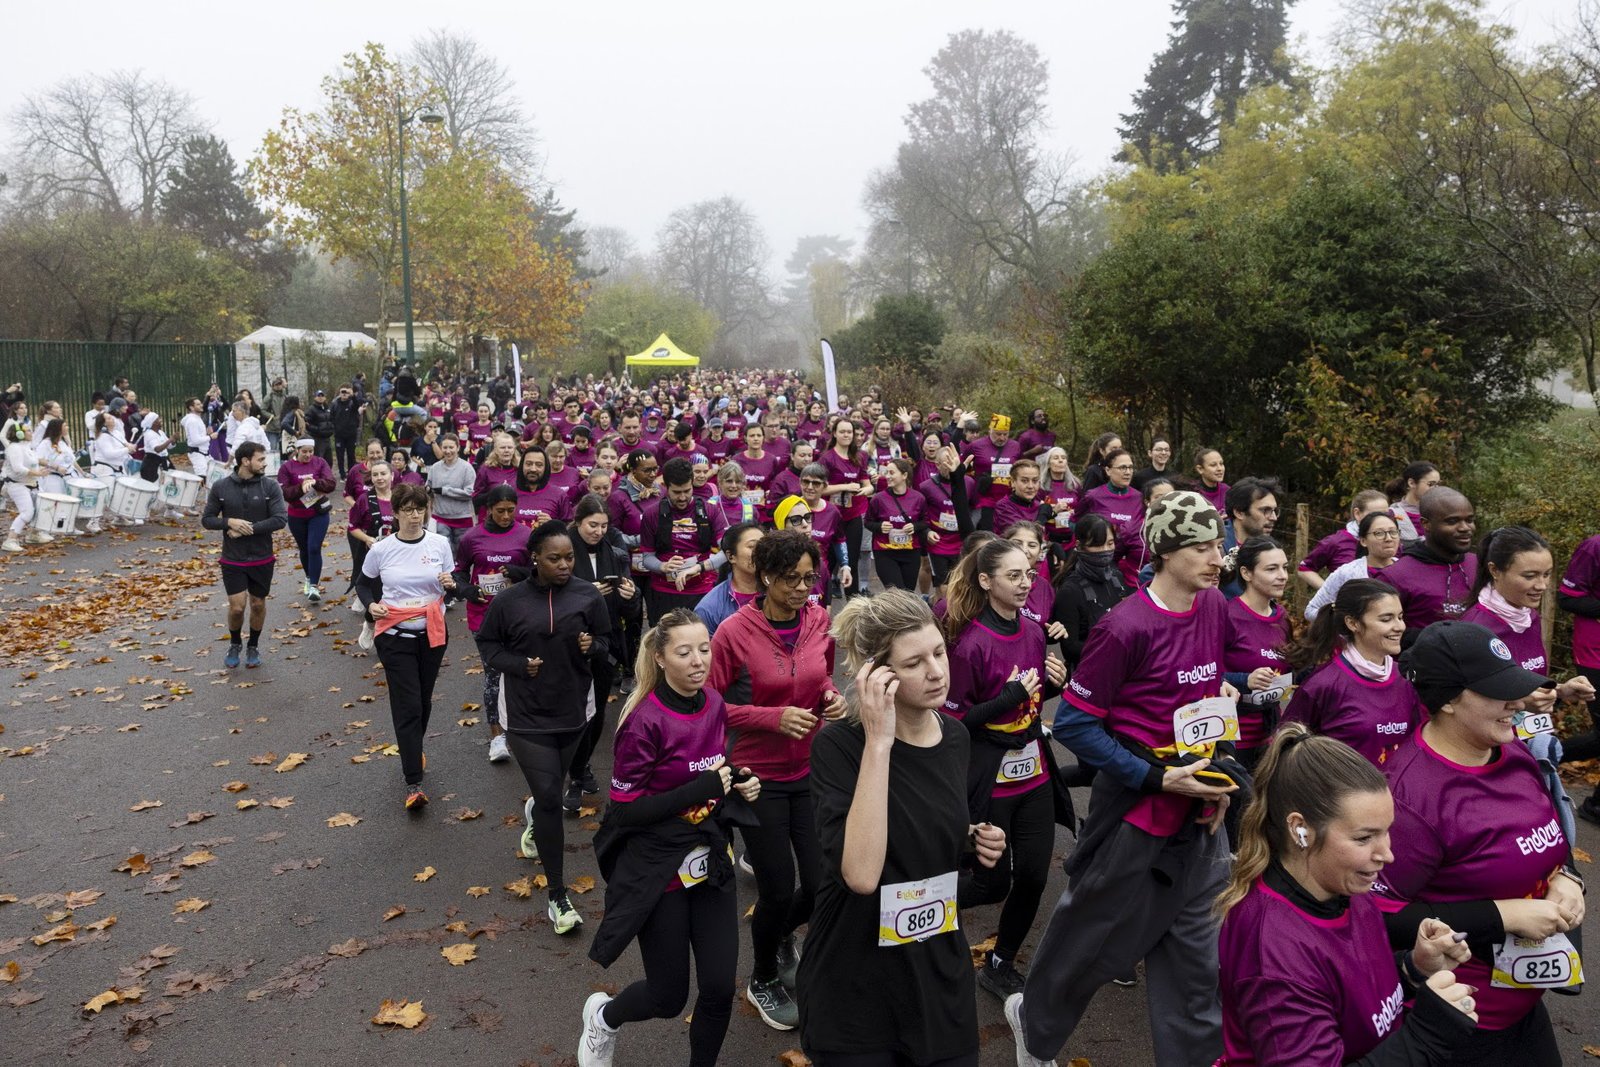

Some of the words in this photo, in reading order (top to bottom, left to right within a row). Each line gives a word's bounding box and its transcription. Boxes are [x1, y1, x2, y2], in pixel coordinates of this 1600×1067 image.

[1192, 722, 1208, 739] 97
[1533, 716, 1549, 730] 92
[1011, 762, 1031, 775] 476
[907, 907, 936, 932] 869
[1525, 958, 1562, 979] 825
